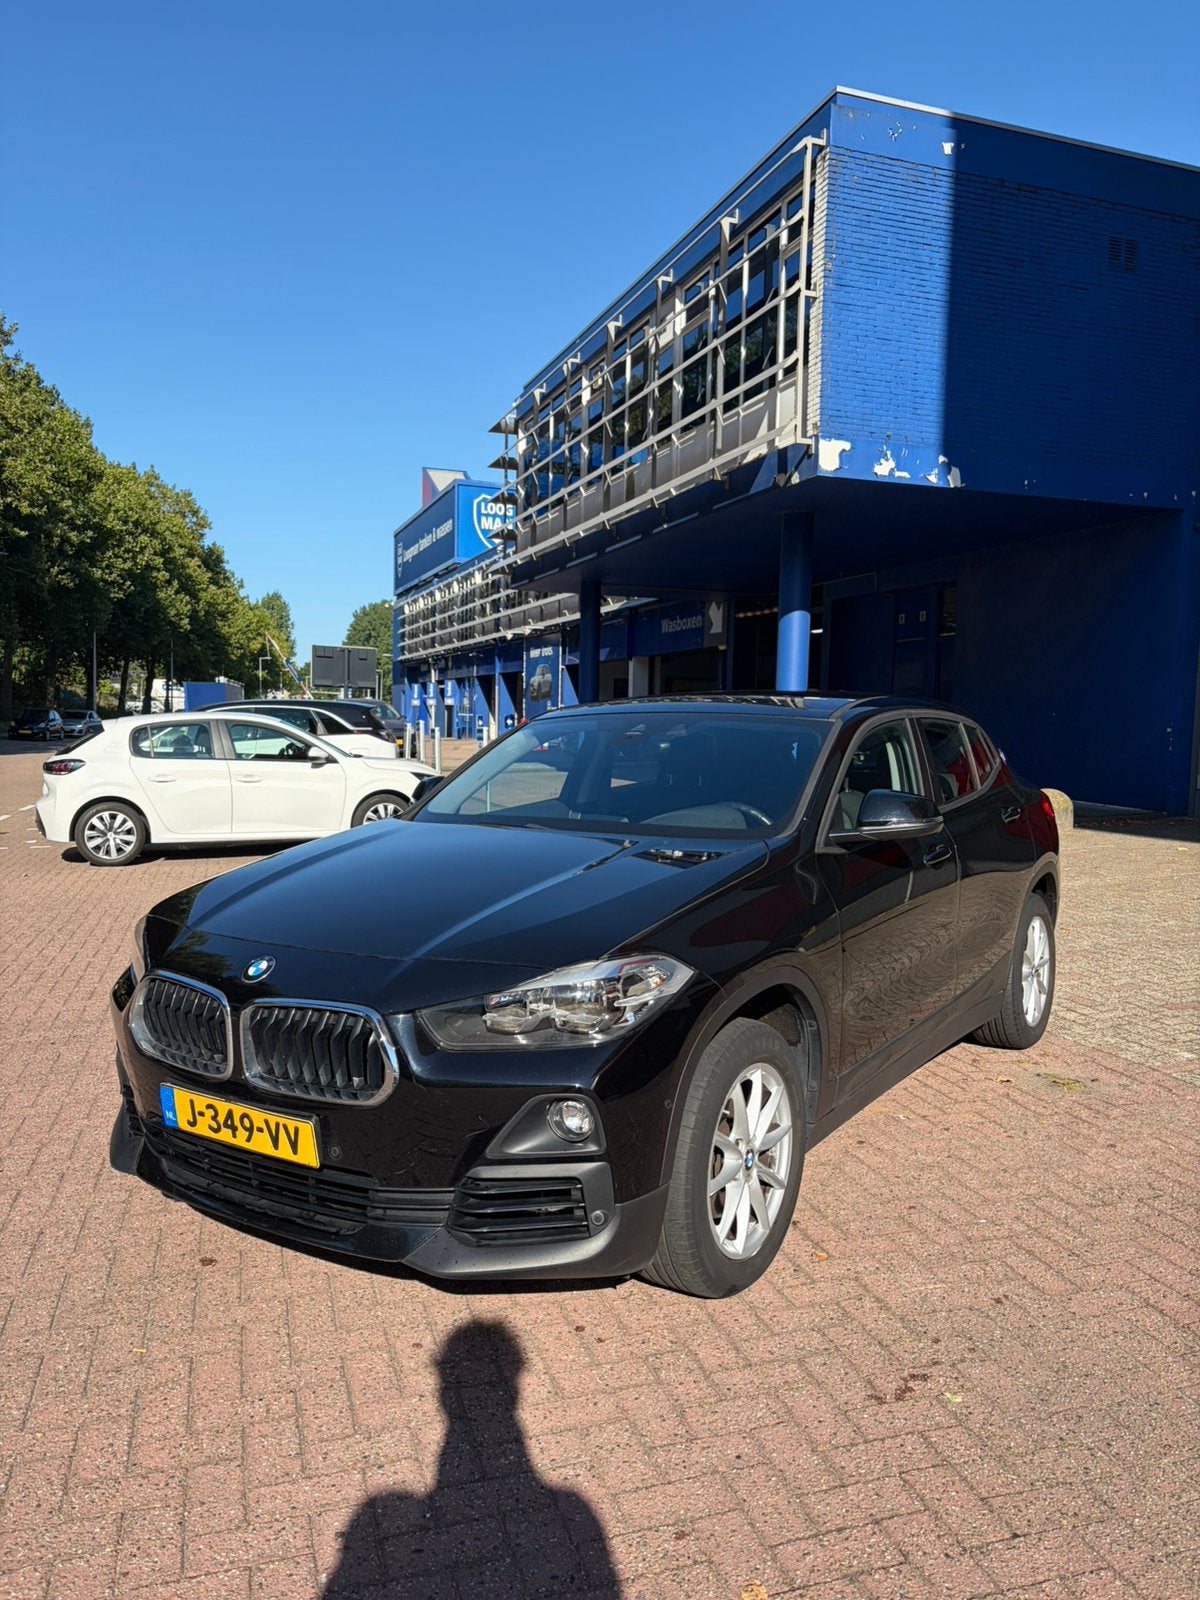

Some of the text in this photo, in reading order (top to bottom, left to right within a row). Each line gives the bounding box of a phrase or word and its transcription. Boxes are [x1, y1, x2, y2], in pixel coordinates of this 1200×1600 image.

[481, 502, 513, 516] LOOG
[661, 615, 702, 633] Wasboxen
[165, 1109, 176, 1120] NL
[187, 1098, 299, 1156] J-349-VV
